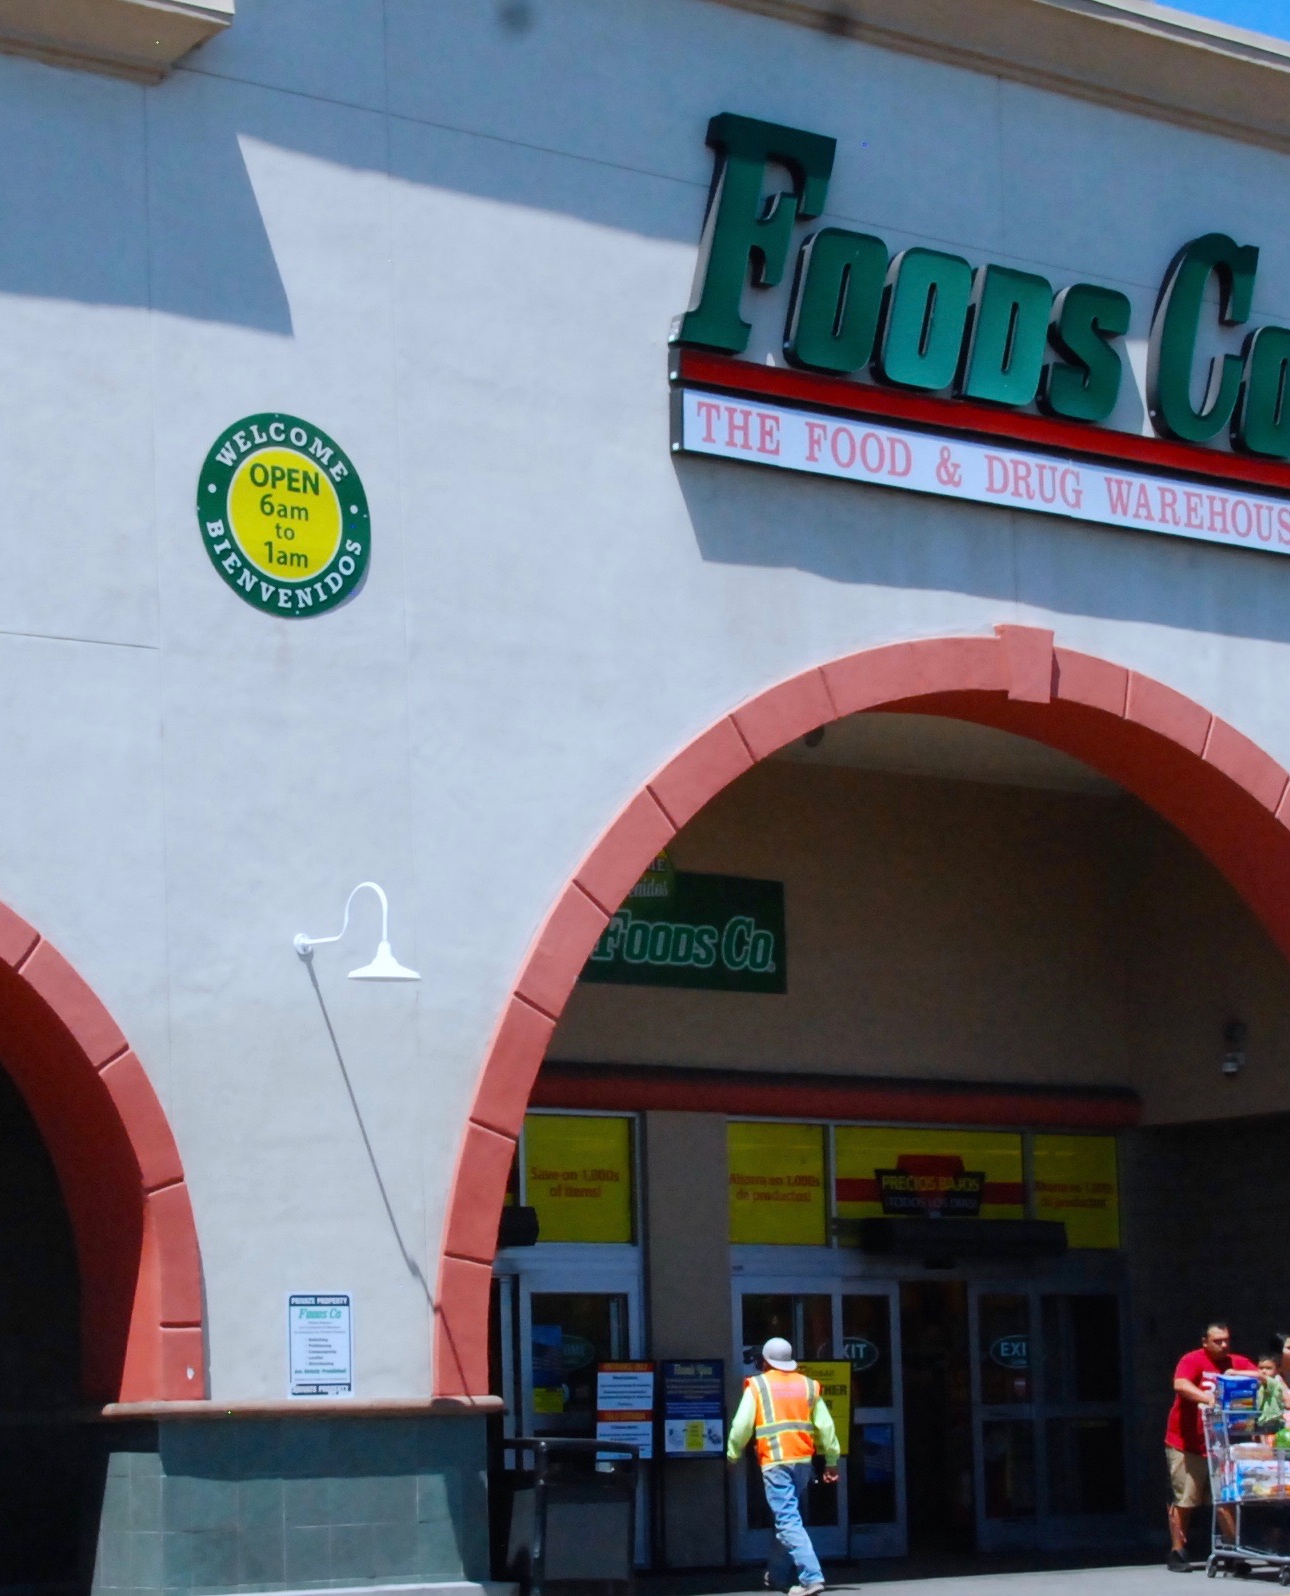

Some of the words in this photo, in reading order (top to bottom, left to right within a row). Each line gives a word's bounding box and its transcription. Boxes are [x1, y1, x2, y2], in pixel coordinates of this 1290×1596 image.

[216, 423, 349, 483] WELCOME
[697, 401, 780, 456] THE
[805, 422, 912, 477] FOOD
[936, 446, 961, 487] &
[985, 454, 1082, 509] DRUG
[249, 463, 320, 495] OPEN
[260, 493, 309, 521] 6am
[275, 523, 295, 540] to
[207, 519, 362, 608] BIENVENIDOS
[264, 541, 309, 568] 1am
[1000, 1341, 1026, 1357] EXI
